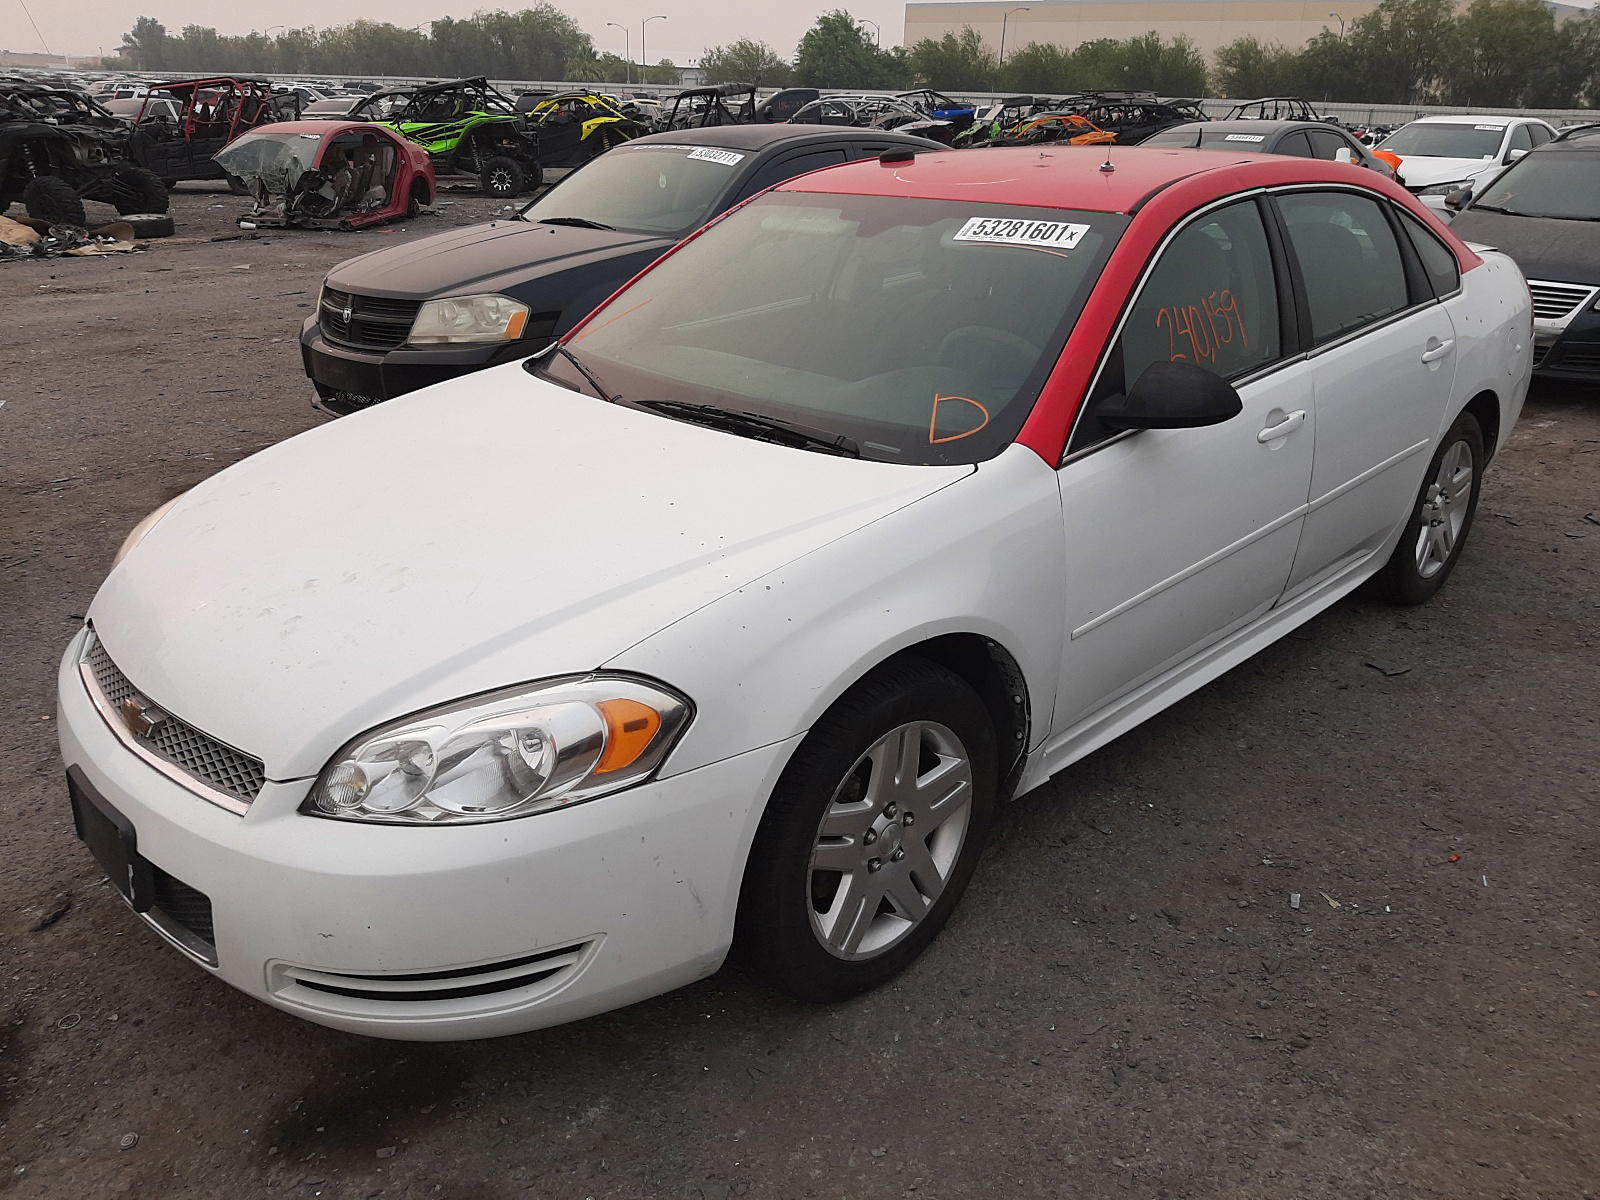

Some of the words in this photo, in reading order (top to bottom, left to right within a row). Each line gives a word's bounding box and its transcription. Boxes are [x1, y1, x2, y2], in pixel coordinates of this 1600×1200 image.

[972, 219, 1070, 242] 53281601
[1155, 288, 1249, 365] 240,159
[929, 393, 990, 444] D
